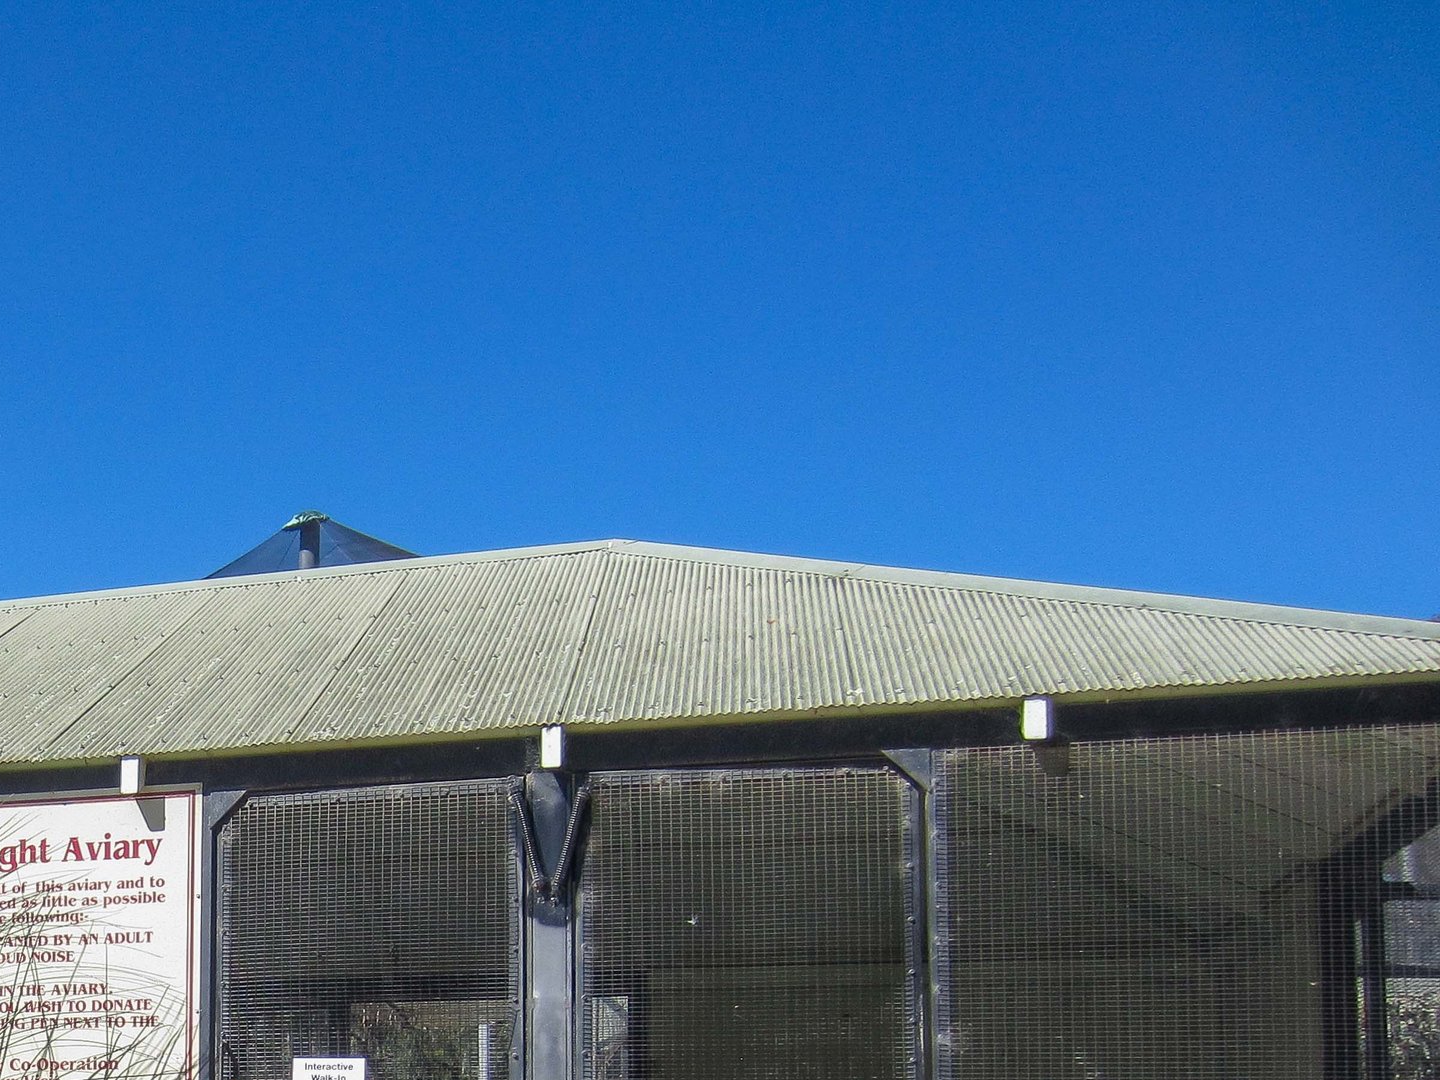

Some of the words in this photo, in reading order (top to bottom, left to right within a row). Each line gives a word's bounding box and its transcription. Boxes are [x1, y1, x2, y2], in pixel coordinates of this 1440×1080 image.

[61, 832, 163, 866] Aviary
[12, 881, 27, 894] of
[35, 880, 63, 893] this
[68, 878, 111, 893] aviary
[117, 876, 144, 889] and
[150, 875, 165, 888] to
[21, 898, 38, 909] as
[42, 894, 76, 908] little
[81, 896, 97, 906] as
[103, 891, 166, 908] possible
[54, 934, 73, 947] BY
[79, 933, 99, 946] AN
[104, 931, 153, 945] ADULT
[32, 950, 75, 964] NOISE
[0, 985, 14, 997] IN
[19, 984, 46, 997] THE
[25, 999, 61, 1013] WISH
[65, 1000, 87, 1013] TO
[92, 998, 152, 1012] DONATE
[31, 1016, 60, 1030] PEN
[63, 1016, 101, 1030] NEXT
[106, 1015, 126, 1028] TO
[132, 1014, 159, 1028] THE
[9, 1055, 119, 1076] Co-Operation
[304, 1062, 354, 1072] Interactive
